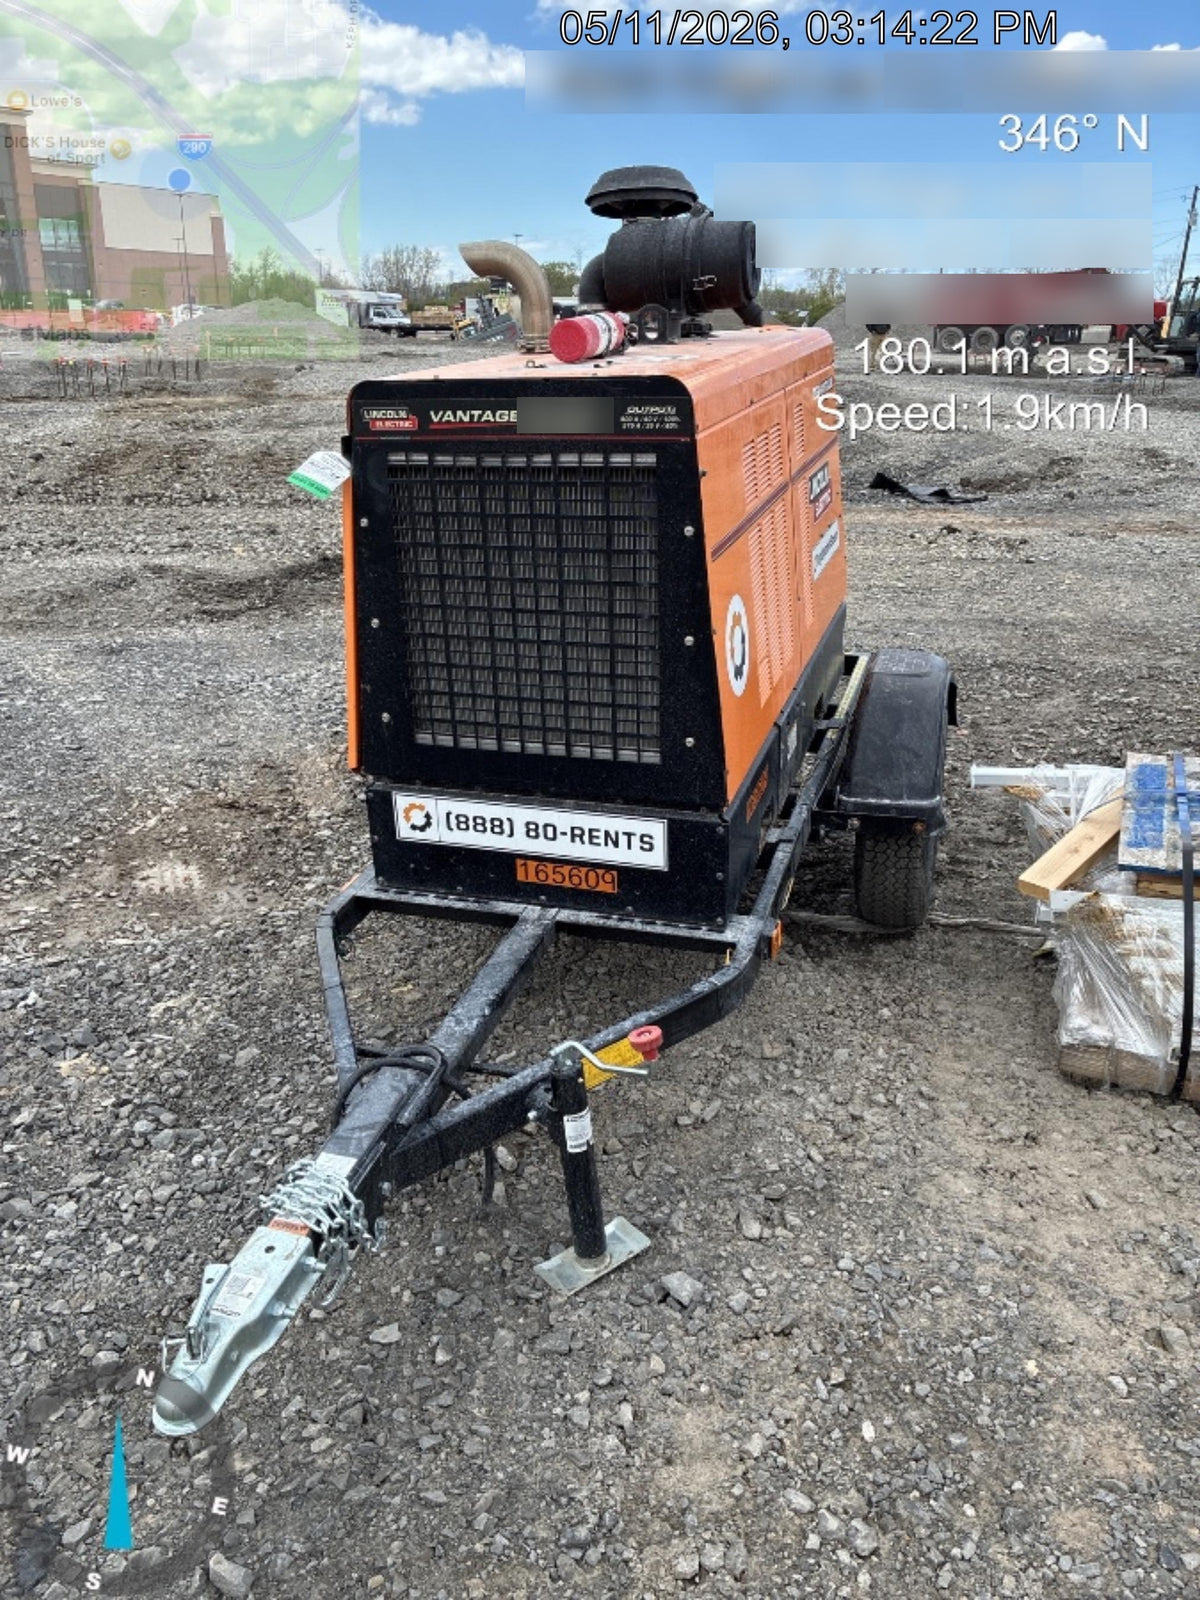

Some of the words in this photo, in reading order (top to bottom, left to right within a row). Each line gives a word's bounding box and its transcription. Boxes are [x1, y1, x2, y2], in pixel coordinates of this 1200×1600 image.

[363, 410, 408, 419] LINCOLN
[429, 410, 518, 422] VANTAGE
[446, 811, 515, 838] (888)
[525, 821, 655, 853] 80-RENTS
[519, 861, 617, 892] 165609
